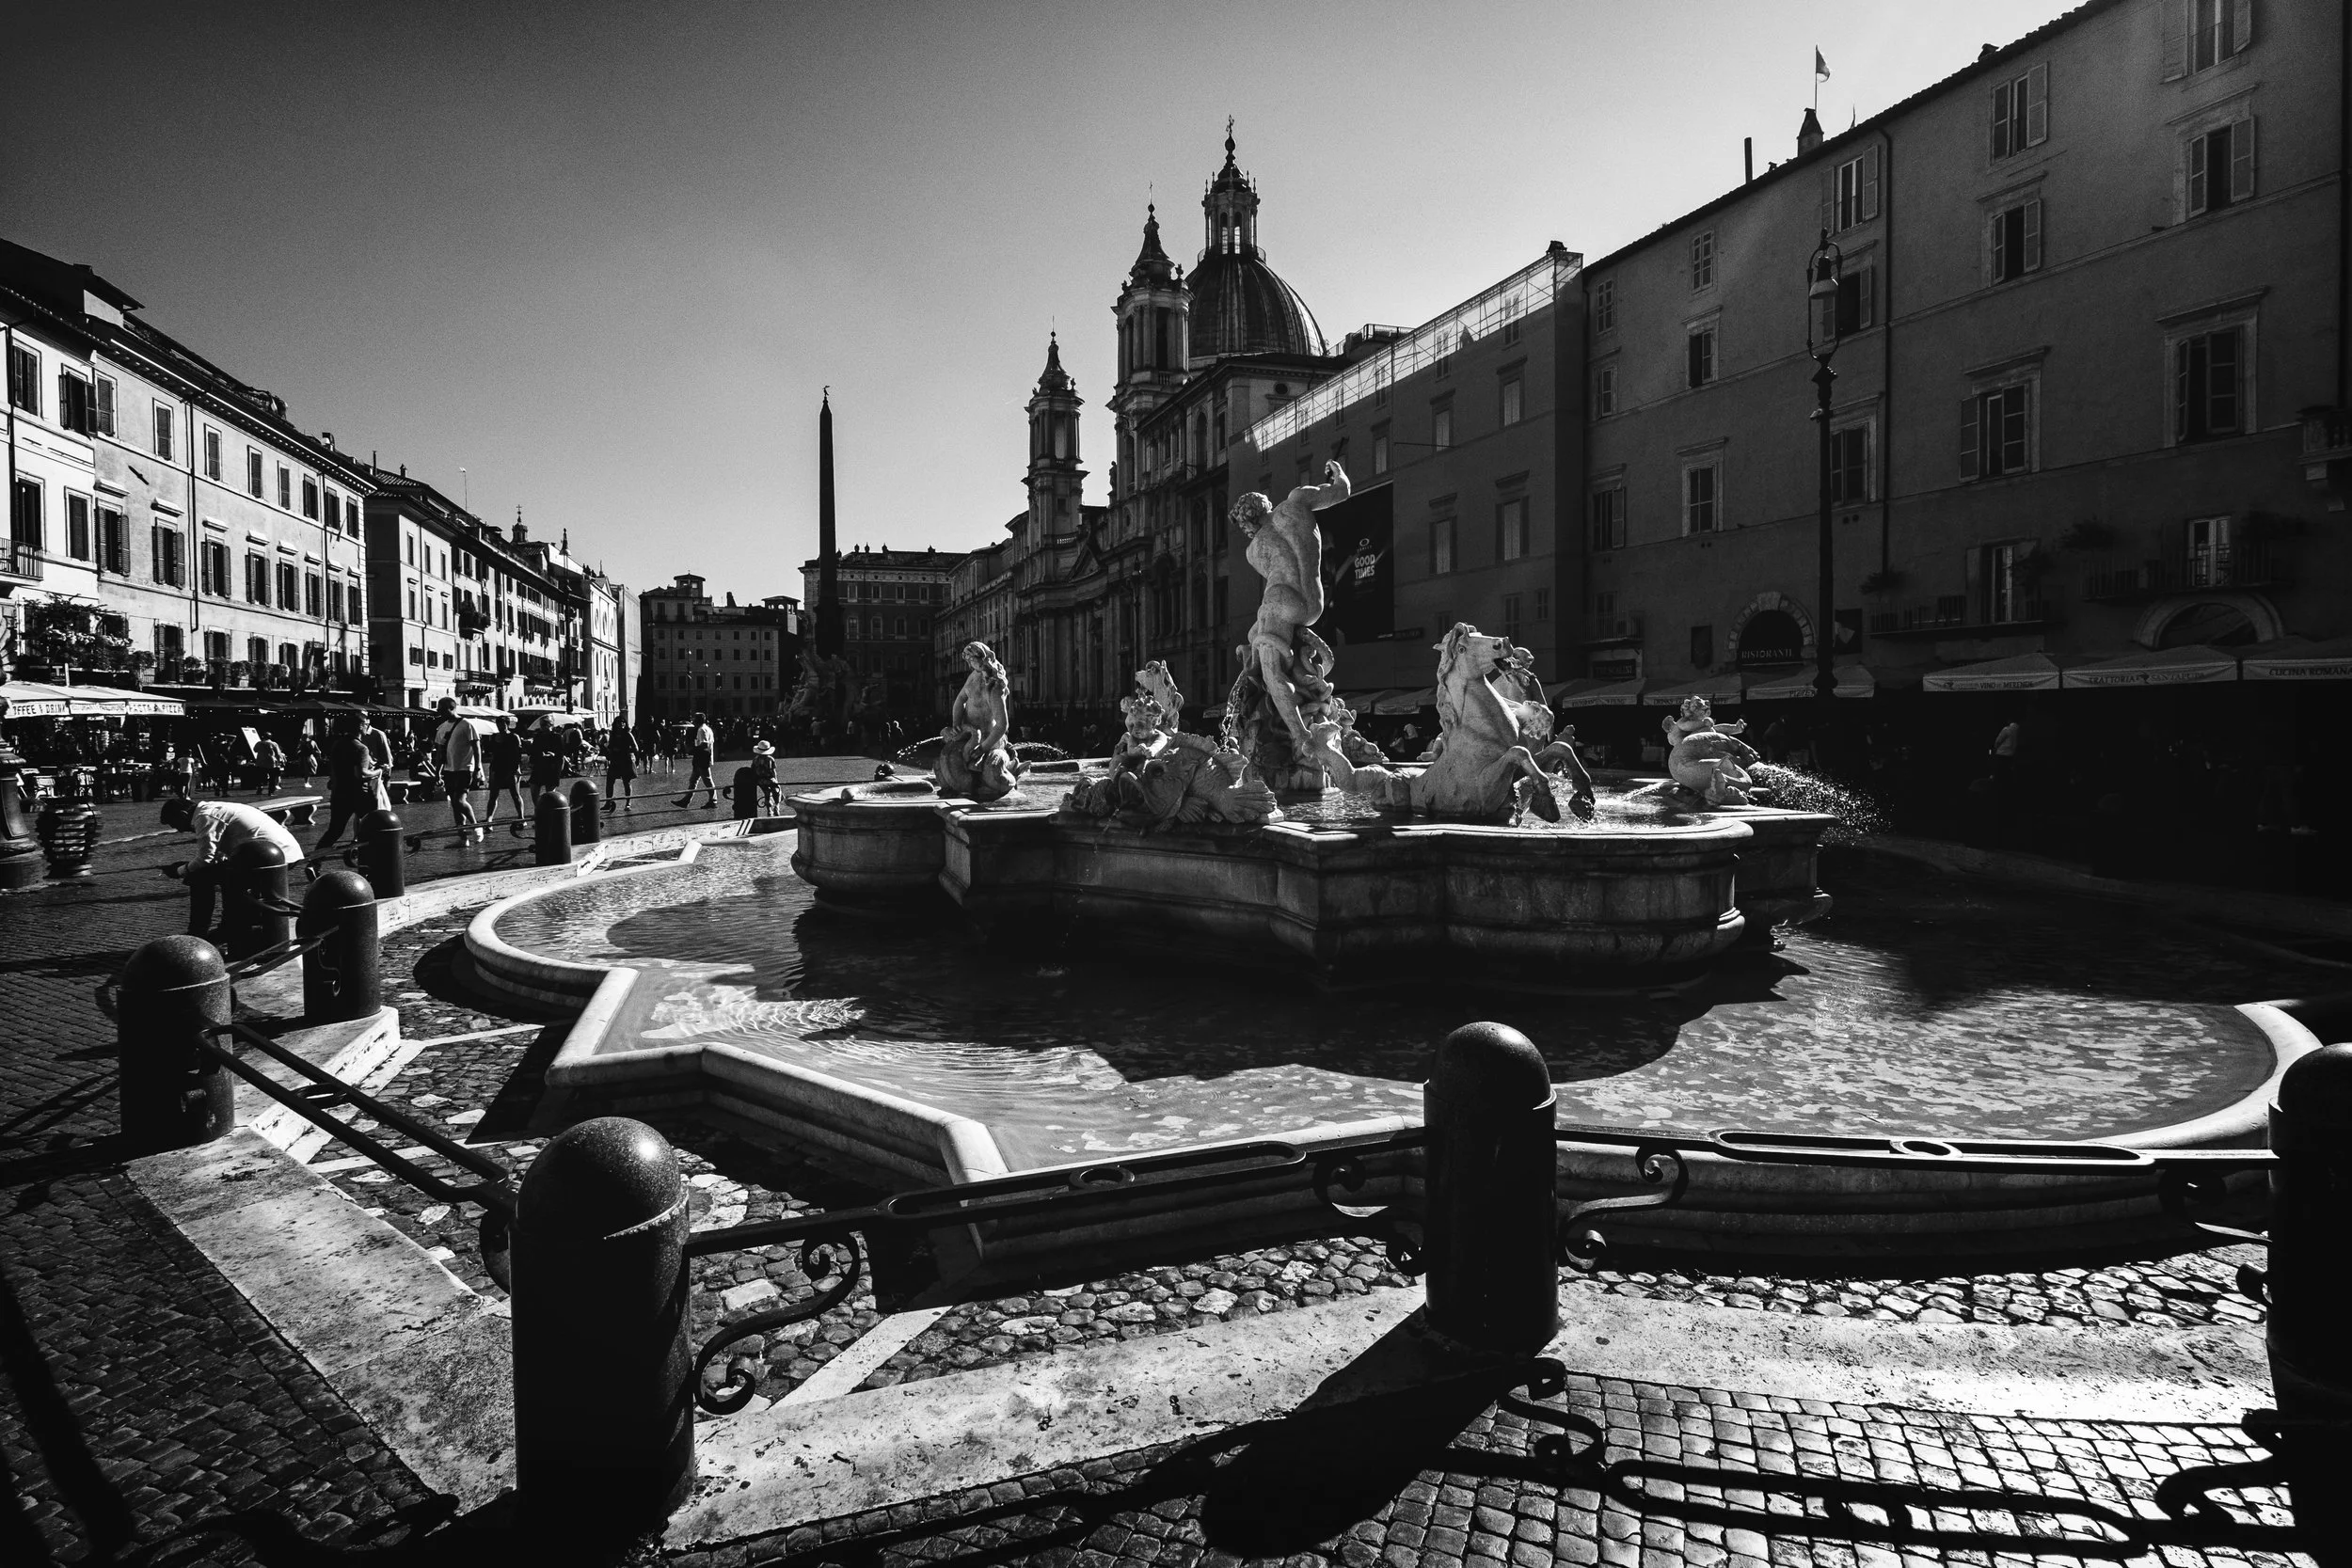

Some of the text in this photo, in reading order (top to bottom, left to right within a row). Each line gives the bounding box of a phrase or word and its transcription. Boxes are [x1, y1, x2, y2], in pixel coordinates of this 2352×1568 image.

[1355, 554, 1375, 568] GOOD
[1355, 565, 1375, 579] TIMES
[2269, 668, 2306, 676] CUCINA
[2089, 675, 2137, 685] TRATTORIA
[129, 704, 151, 712] PASTA
[162, 705, 183, 714] PIZZA
